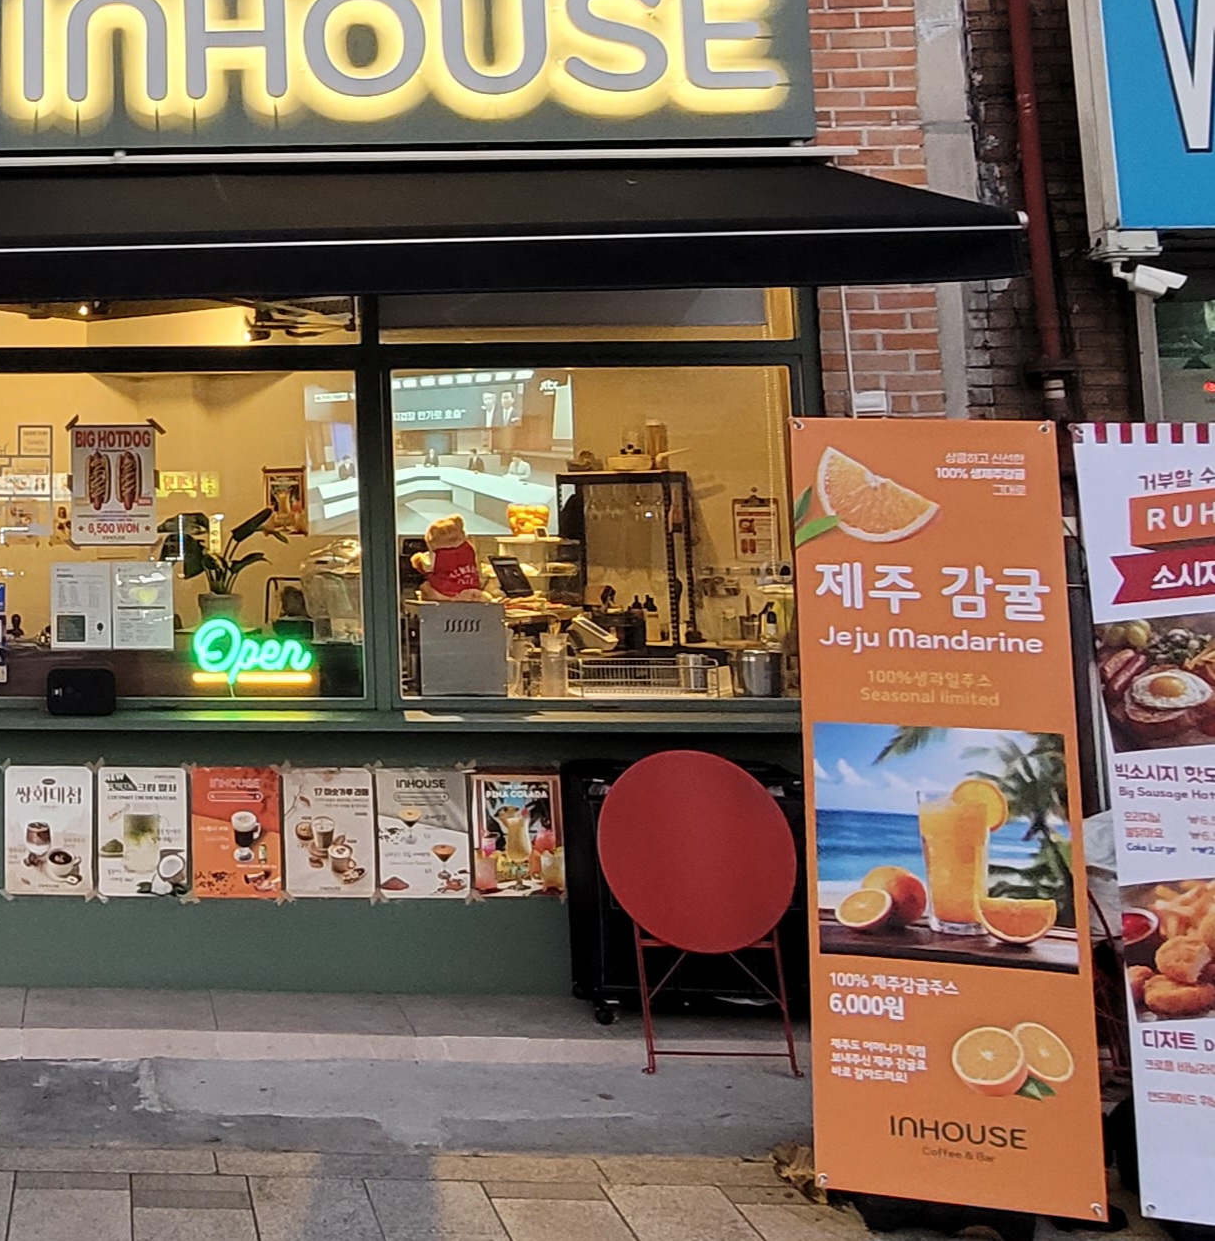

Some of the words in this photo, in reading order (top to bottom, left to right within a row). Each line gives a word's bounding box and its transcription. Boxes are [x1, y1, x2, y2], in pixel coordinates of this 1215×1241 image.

[75, 430, 96, 448] BIG
[97, 430, 151, 448] HOTDOG
[935, 467, 968, 479] 100%
[1139, 469, 1193, 491] 거부할
[88, 523, 115, 536] 6,500
[116, 523, 140, 534] WON
[815, 562, 922, 615] 제주
[941, 565, 1051, 622] 감귤
[819, 626, 880, 653] Jeju
[888, 628, 1044, 654] Mandarine
[193, 619, 312, 684] Open
[860, 687, 935, 704] Seasonal
[940, 689, 1000, 707] limited
[209, 777, 262, 789] INHOUSE
[1114, 763, 1179, 783] 빅소시지
[395, 779, 447, 789] INHOUSE
[1118, 786, 1134, 799] Big
[1136, 786, 1188, 801] Sausage
[829, 972, 870, 989] 100%
[872, 974, 961, 996] 제주감귤주스
[829, 993, 906, 1021] 6,000원
[1142, 1029, 1198, 1051] 디저트
[890, 1115, 1028, 1150] INHOUSE
[922, 1146, 962, 1160] Coffee
[975, 1151, 995, 1162] Bar
